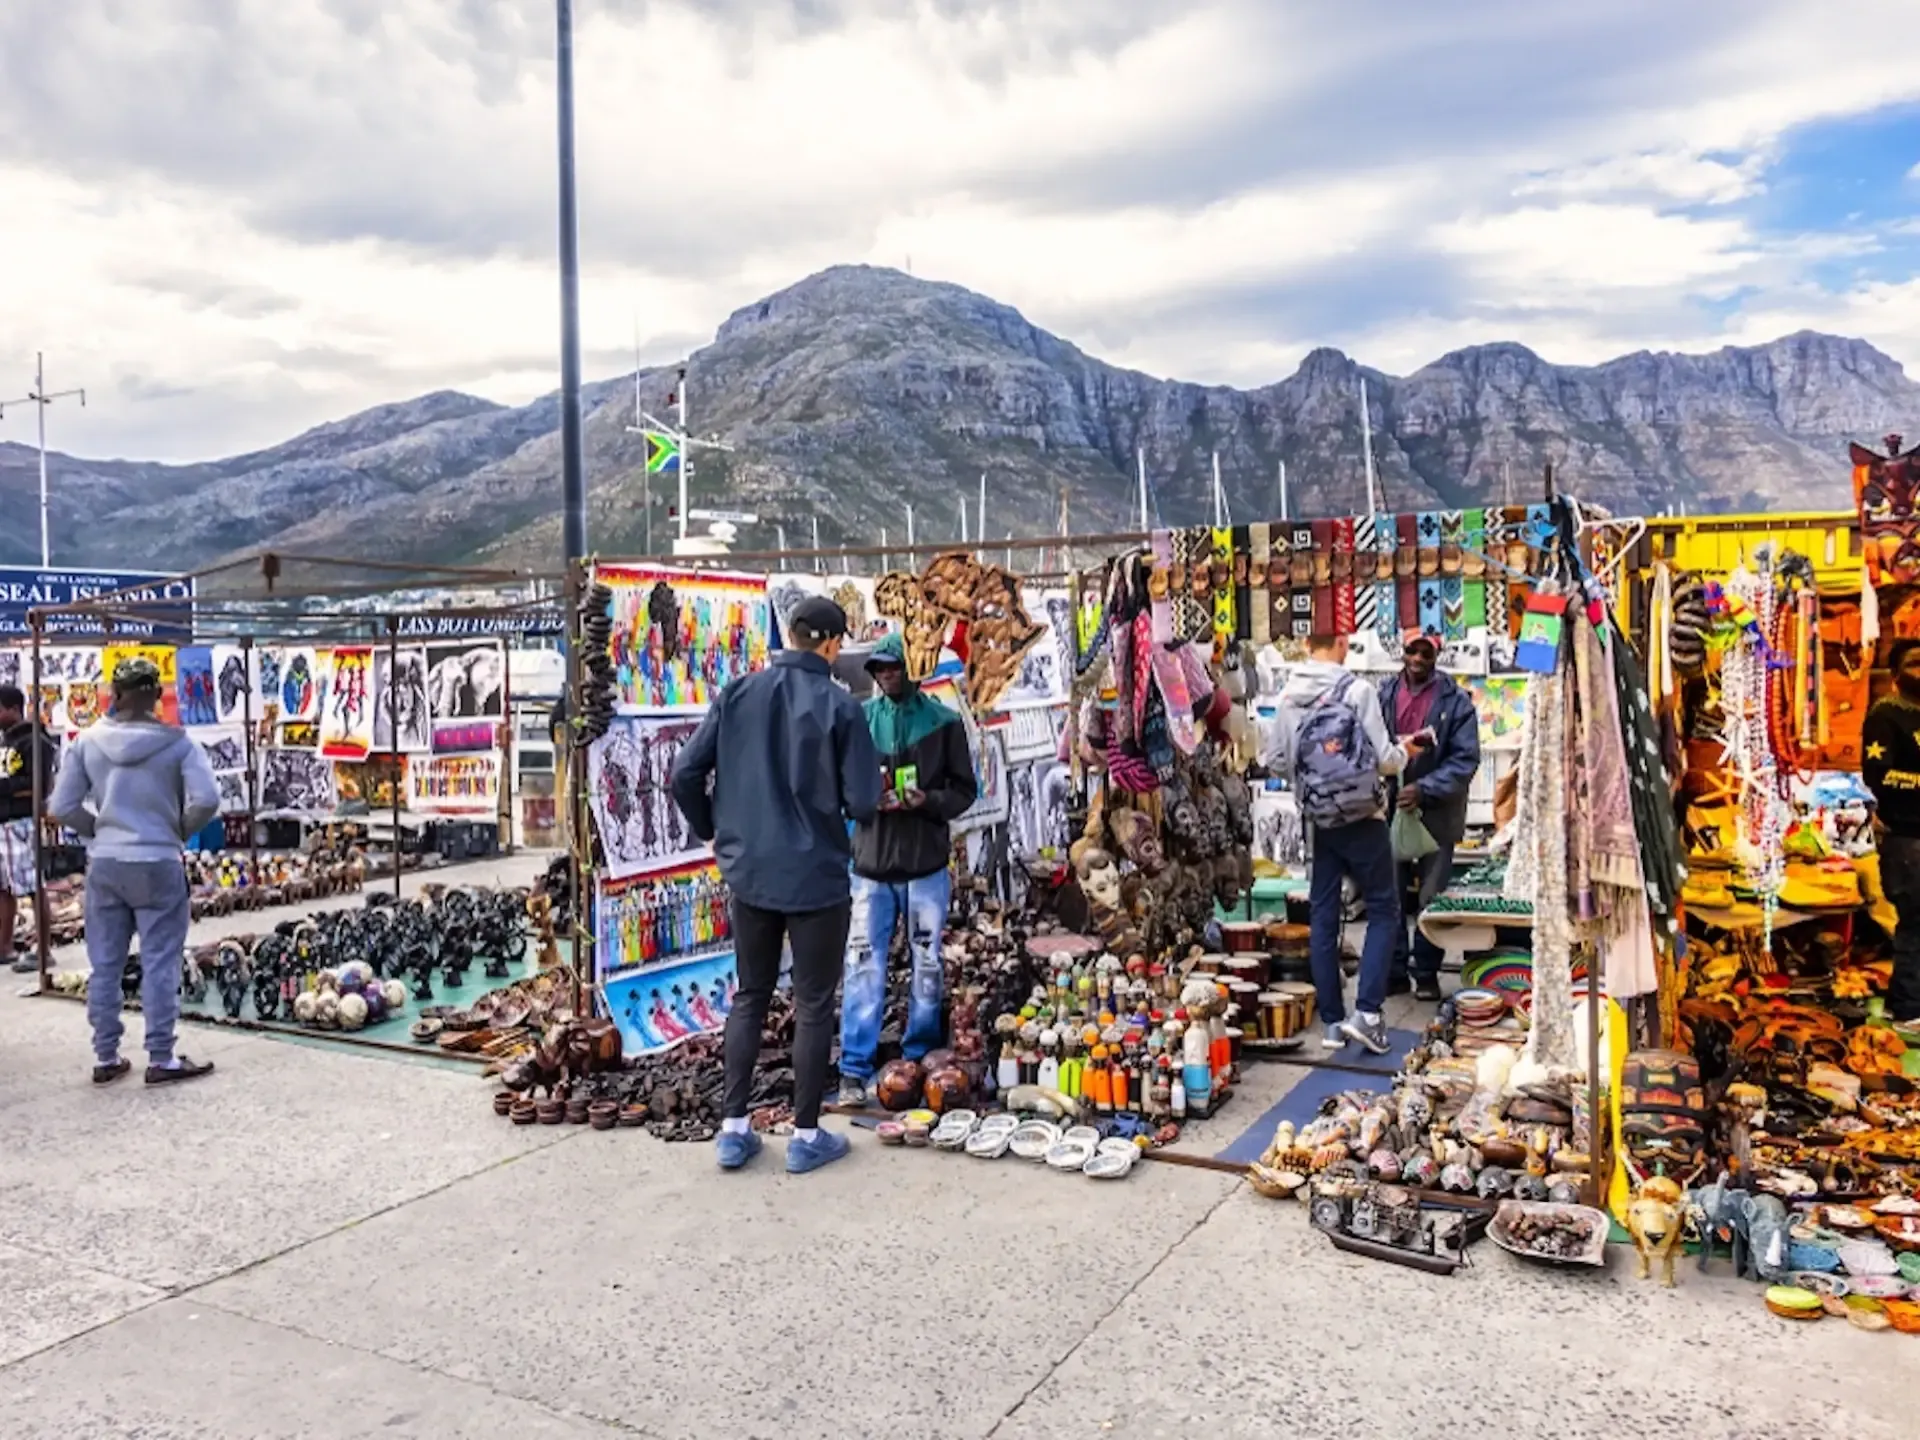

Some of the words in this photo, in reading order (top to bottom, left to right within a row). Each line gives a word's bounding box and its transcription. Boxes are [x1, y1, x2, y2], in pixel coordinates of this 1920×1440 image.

[0, 582, 60, 602] SEAL
[45, 621, 119, 634] BOTTOMD
[386, 616, 434, 636] LASS
